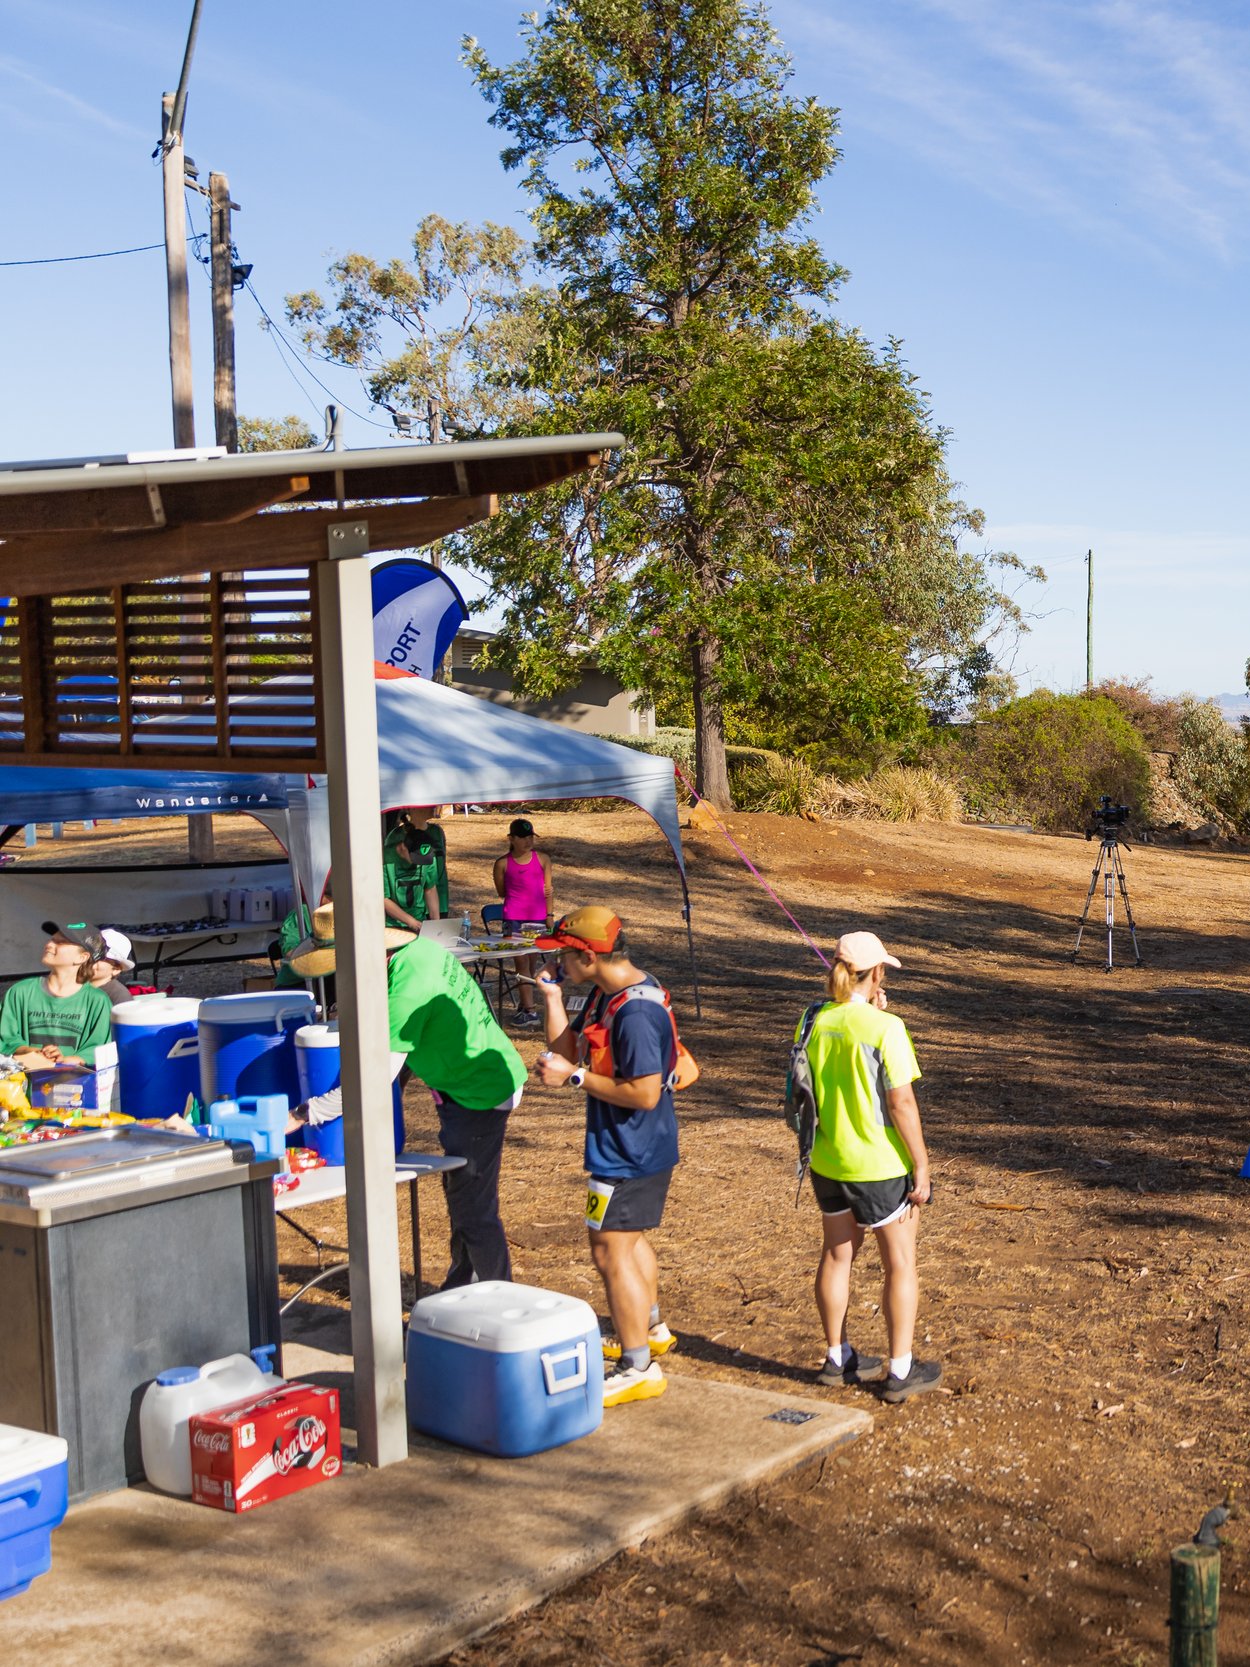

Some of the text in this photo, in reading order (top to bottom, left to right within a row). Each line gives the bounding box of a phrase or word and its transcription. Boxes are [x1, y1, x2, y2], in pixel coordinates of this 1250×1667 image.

[136, 796, 251, 809] Wanderer
[194, 1429, 229, 1452] Coca-Cola
[273, 1416, 326, 1475] Coca-Cola
